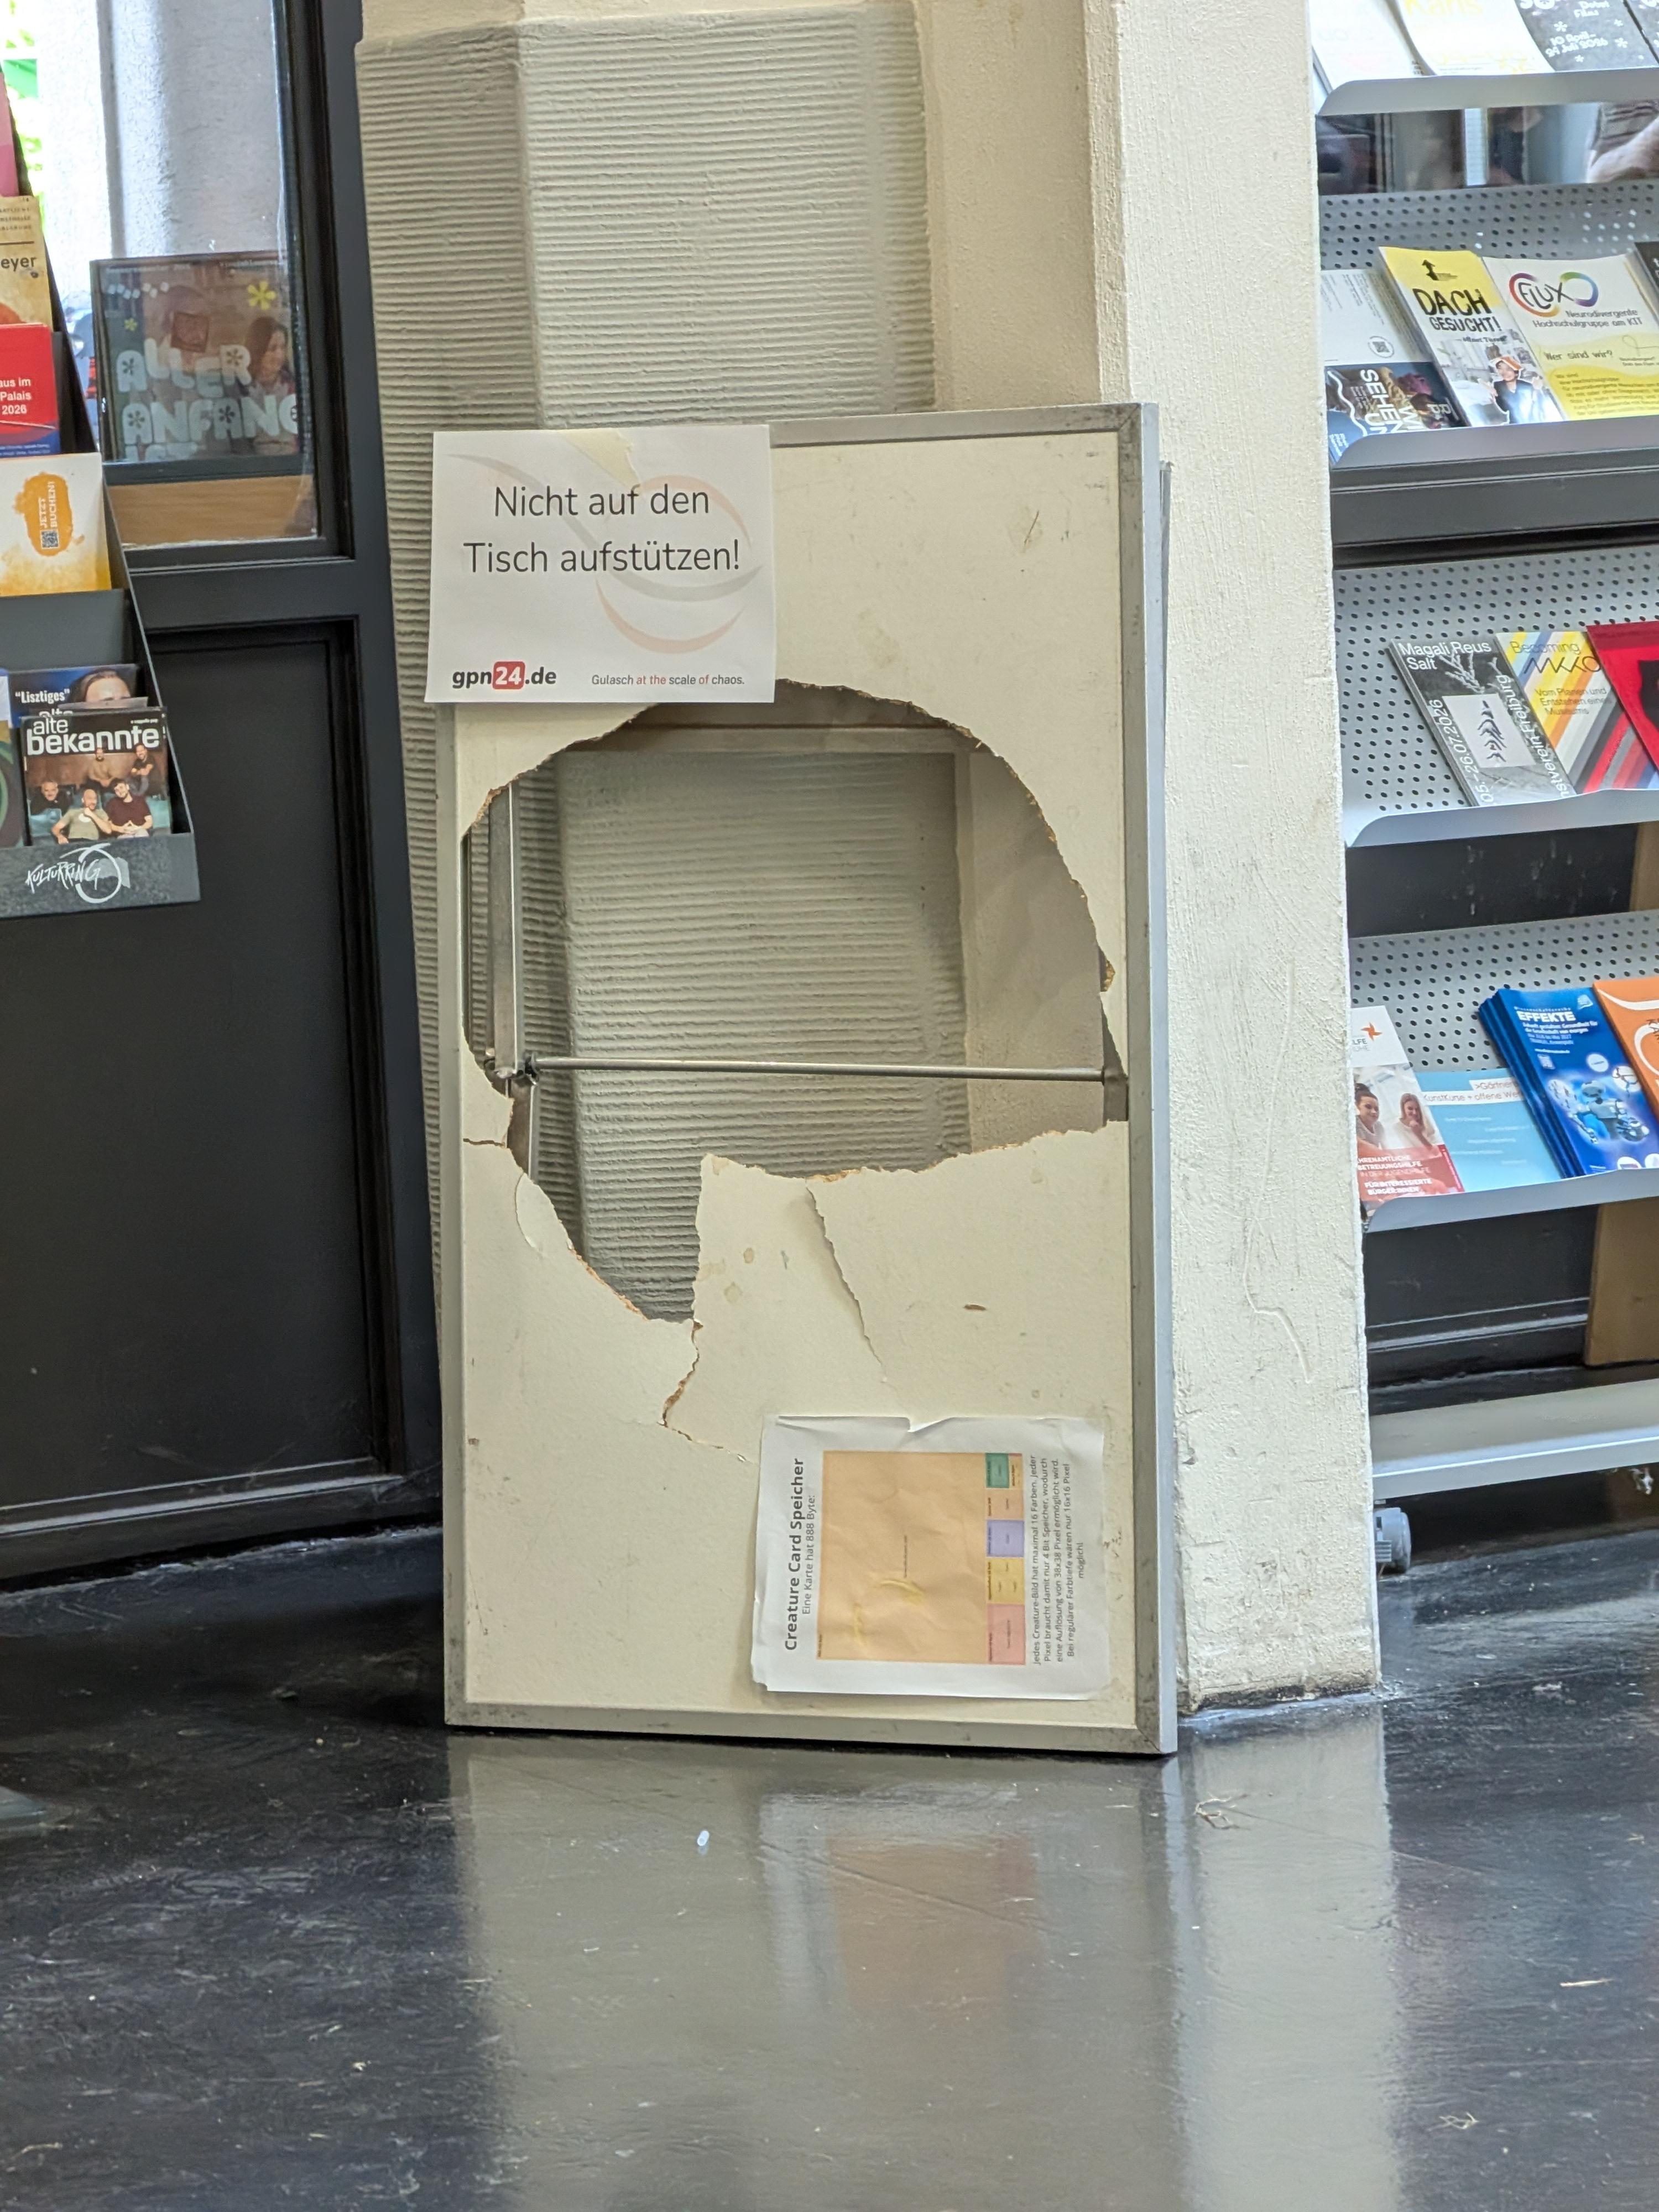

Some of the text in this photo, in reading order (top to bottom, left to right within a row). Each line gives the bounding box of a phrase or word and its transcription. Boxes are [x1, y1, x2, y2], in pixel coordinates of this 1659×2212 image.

[1412, 289, 1493, 316] DACH
[1518, 282, 1575, 310] FLUX
[1429, 316, 1503, 332] GESUCHT!
[1532, 319, 1609, 328] Hochschulgruppe
[1566, 309, 1638, 318] Neurodivergente
[1543, 349, 1613, 361] Wer sind wir?
[0, 390, 32, 401] Palais
[18, 377, 32, 387] im
[2, 404, 27, 415] 2026
[1360, 369, 1407, 433] SEHEN
[38, 497, 48, 528] JETZT
[48, 481, 58, 528] BUCHEN!
[495, 483, 710, 517] Nicht auf den
[463, 539, 740, 573] Tisch aufstützen!
[1399, 641, 1492, 657] Magali Reus
[1510, 641, 1582, 655] Becoming
[452, 665, 745, 689] gpn24.de Gulasch at the scale of chaos.
[1407, 657, 1437, 670] Salt
[1496, 675, 1536, 735] Freiburg
[33, 714, 69, 735] alte
[27, 725, 160, 755] bekannte
[25, 859, 101, 894] KULTURRING
[1516, 1011, 1576, 1022] EFFEKTE
[1042, 1498, 1051, 1537] Speicher,
[1052, 1482, 1062, 1528] ermöglicht
[1032, 1514, 1038, 1524] 16
[785, 1458, 805, 1651] Creature Card Speicher
[802, 1495, 817, 1615] Eine Karte hat 888 Byte:
[1065, 1561, 1073, 1599] Farbtiefe
[1031, 1582, 1040, 1640] Creature-Bild
